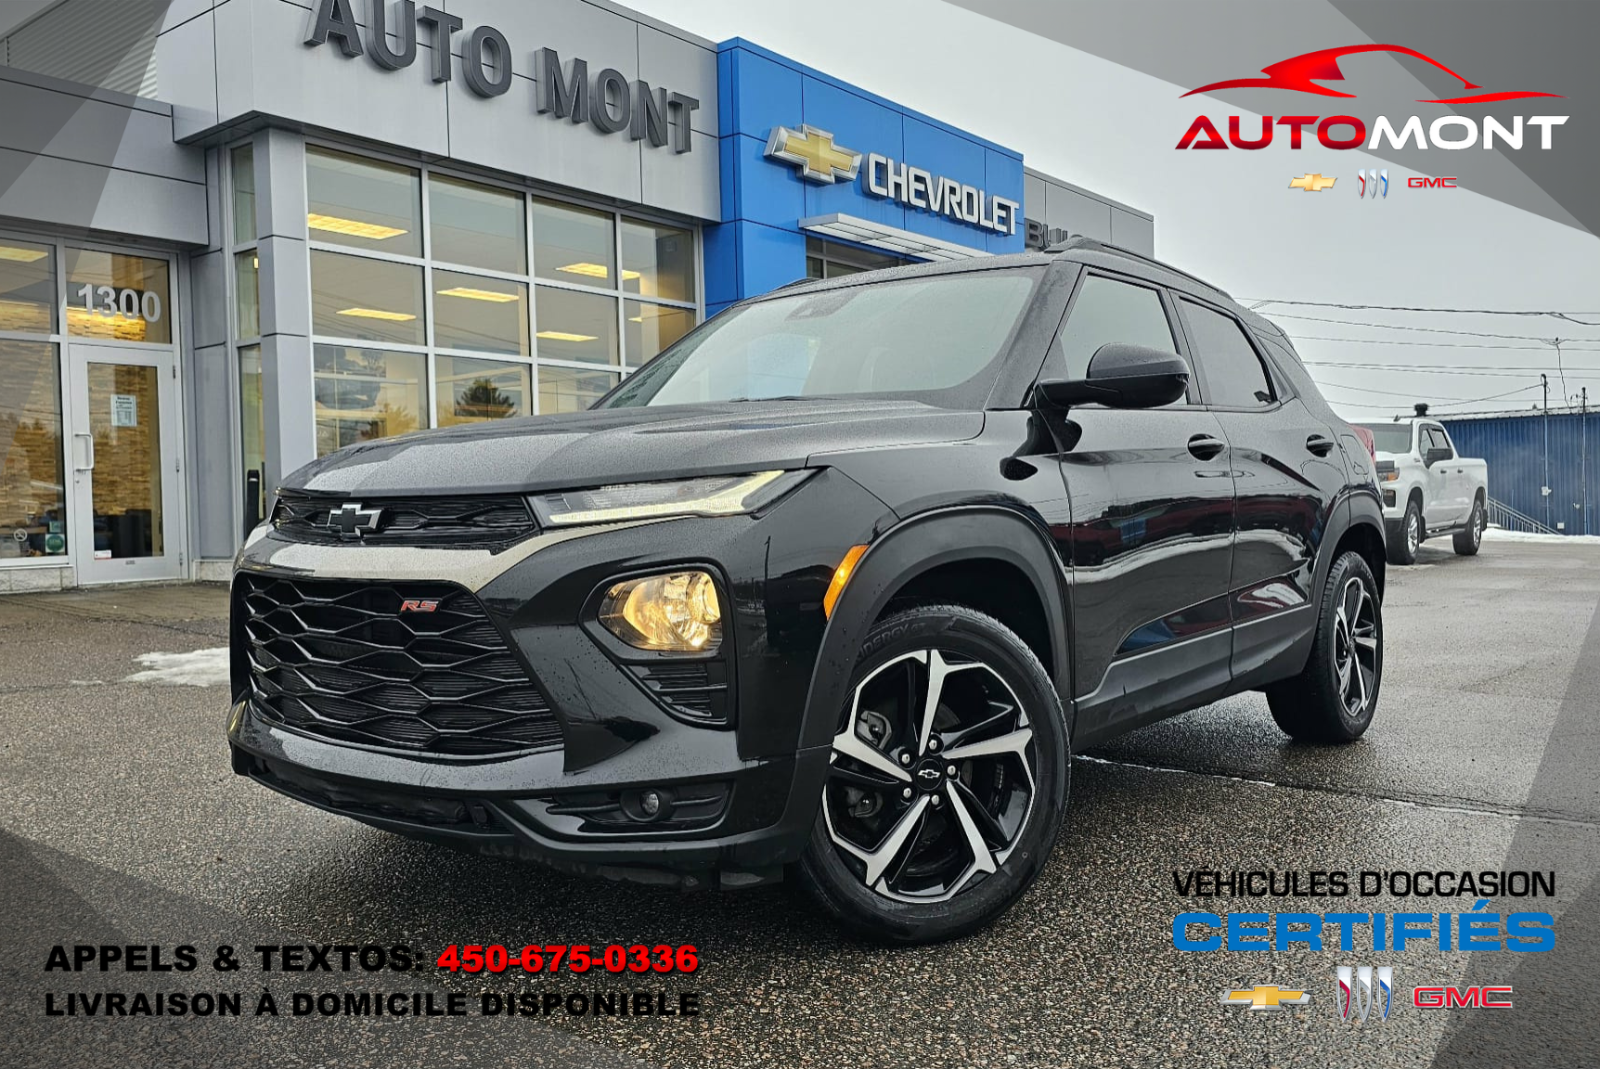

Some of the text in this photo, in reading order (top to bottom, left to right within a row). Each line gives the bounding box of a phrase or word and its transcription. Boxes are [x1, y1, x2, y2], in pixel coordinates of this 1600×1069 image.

[303, 0, 700, 154] AUTO MONT
[865, 152, 1020, 236] CHEVROLET
[76, 283, 162, 324] 1300
[400, 600, 440, 612] RS
